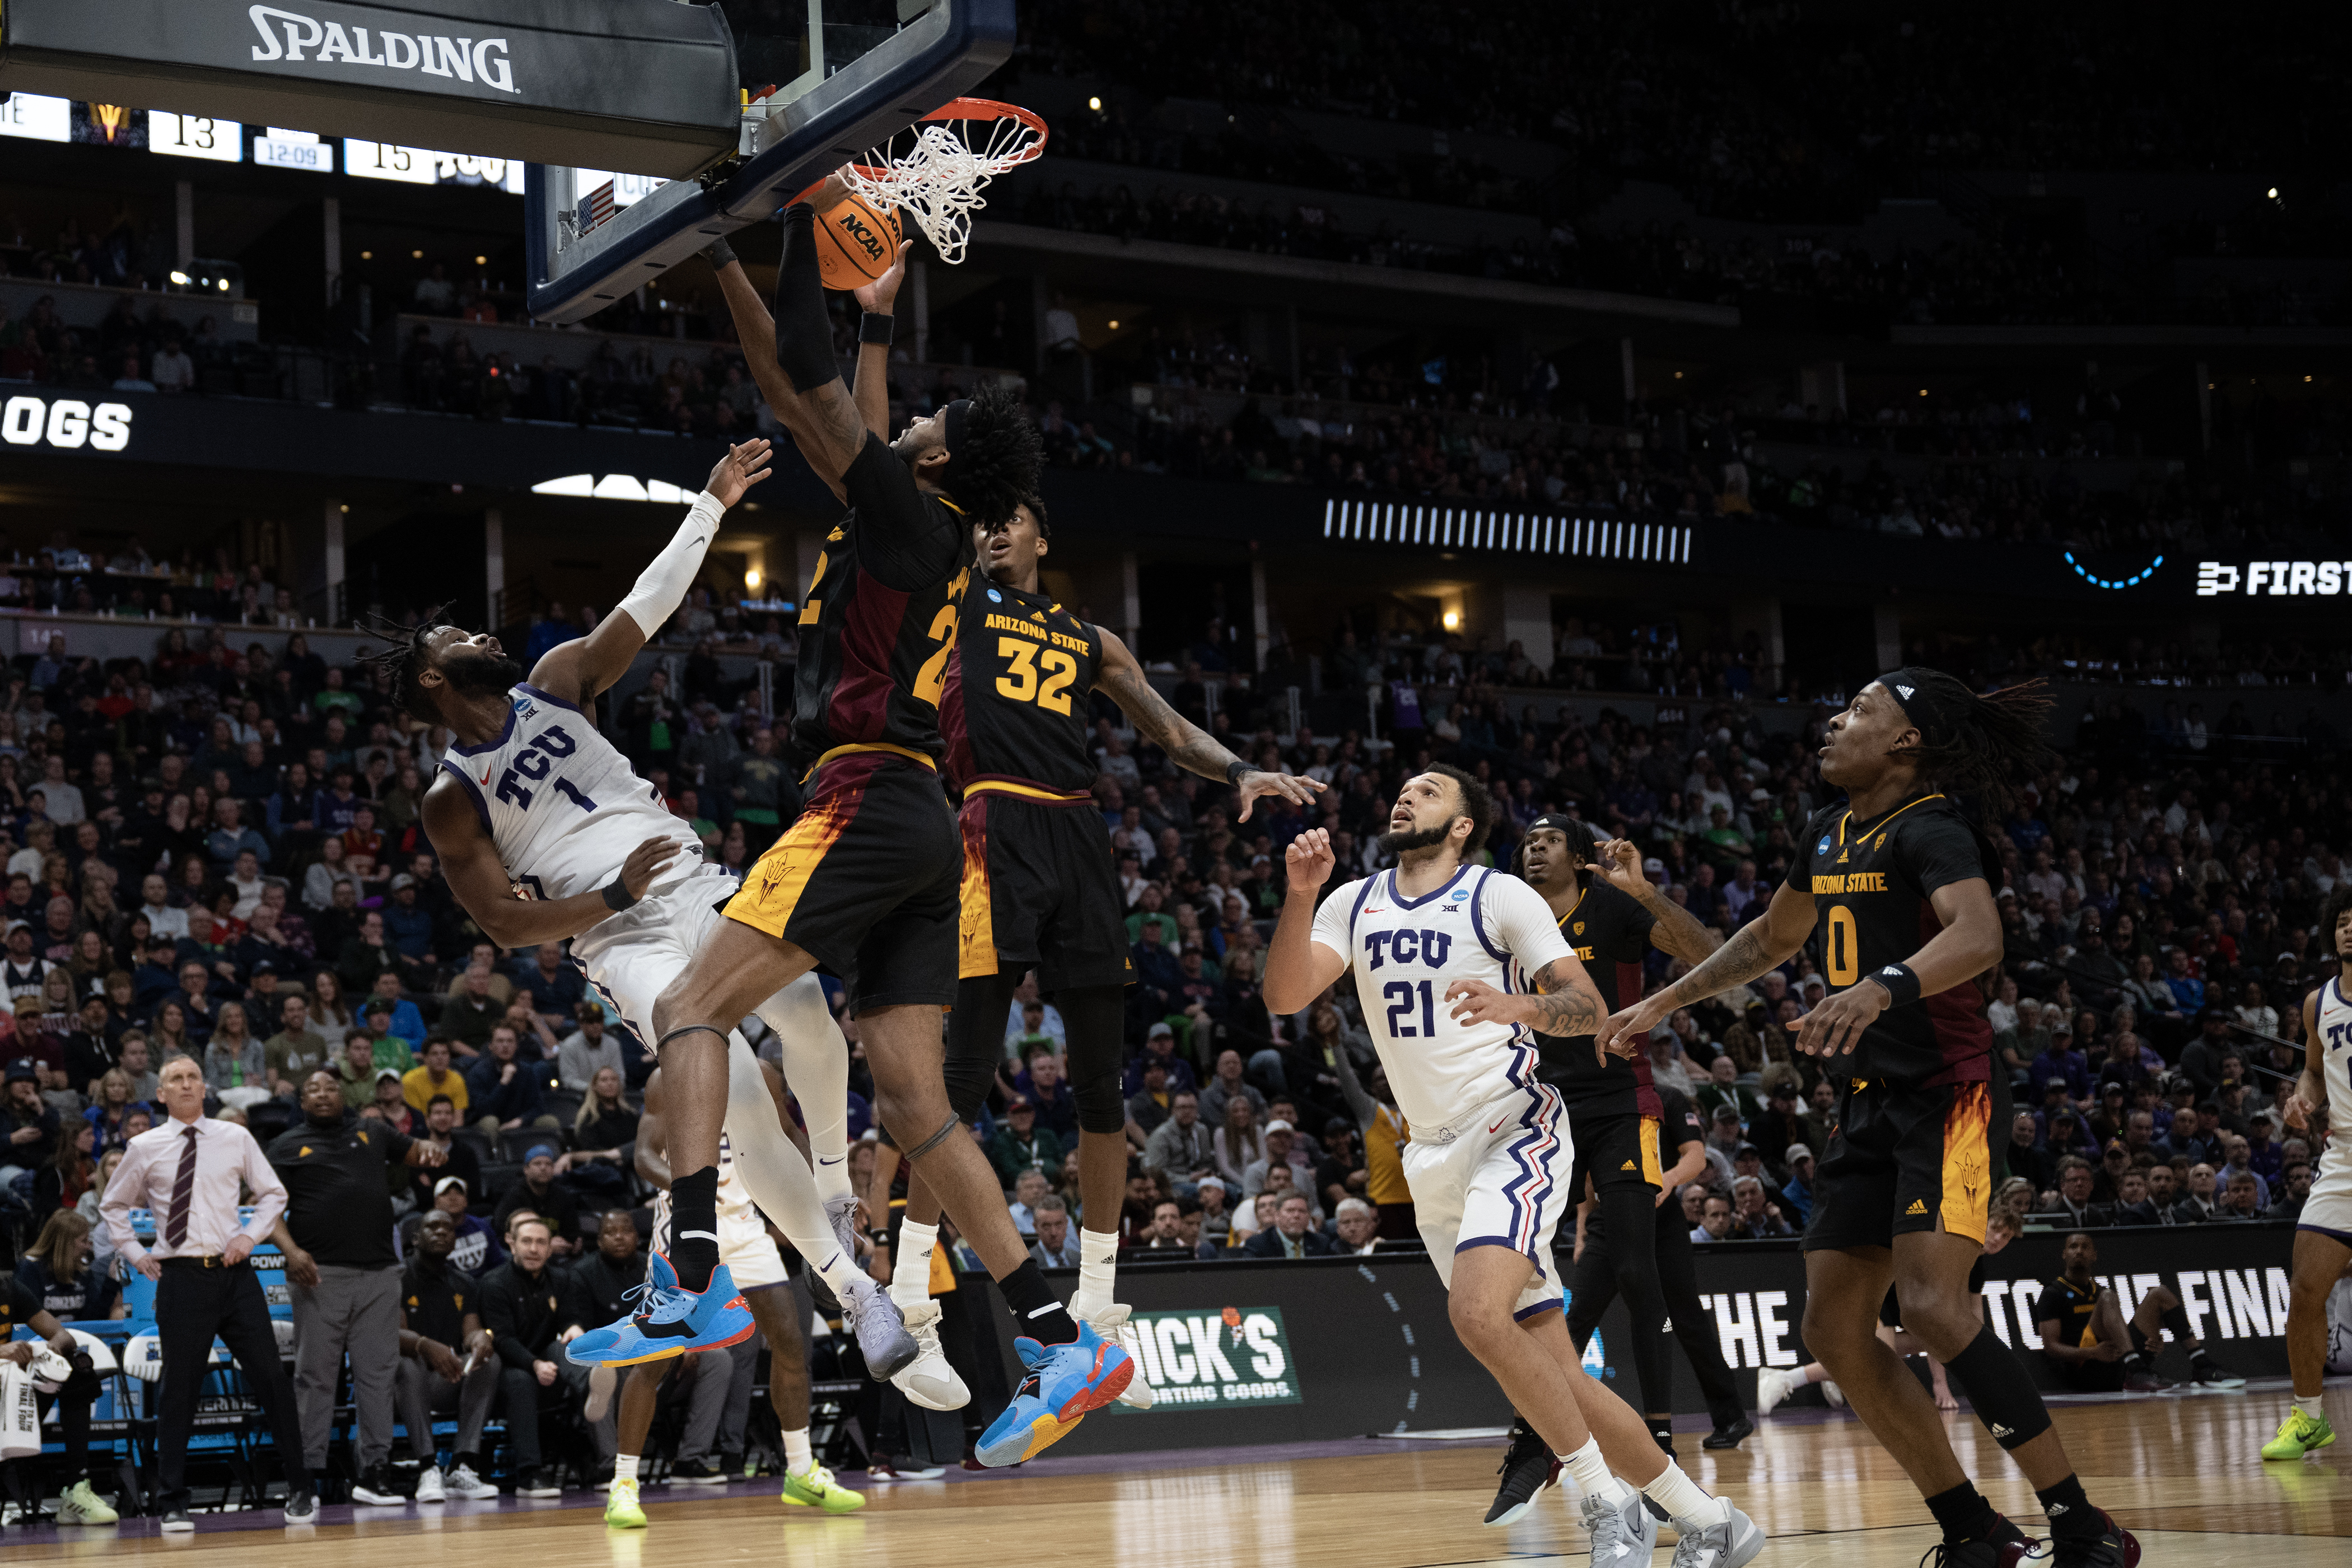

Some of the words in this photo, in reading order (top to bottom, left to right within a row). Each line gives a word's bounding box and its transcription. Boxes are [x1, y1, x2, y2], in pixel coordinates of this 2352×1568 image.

[249, 4, 514, 94] SPALDING
[174, 114, 214, 149] 13
[374, 143, 410, 171] 15
[839, 212, 885, 262] NCAA
[984, 613, 1048, 641] ARIZONA
[1051, 631, 1090, 657] STATE
[996, 636, 1077, 717] 32
[517, 699, 530, 711] NCAA
[495, 724, 576, 813] TCU
[553, 776, 598, 814] 1
[1846, 872, 1888, 893] STATE
[1365, 928, 1452, 972] TCU
[1827, 906, 1859, 986] 0
[1383, 980, 1435, 1038] 21
[1698, 1291, 1798, 1369] HE
